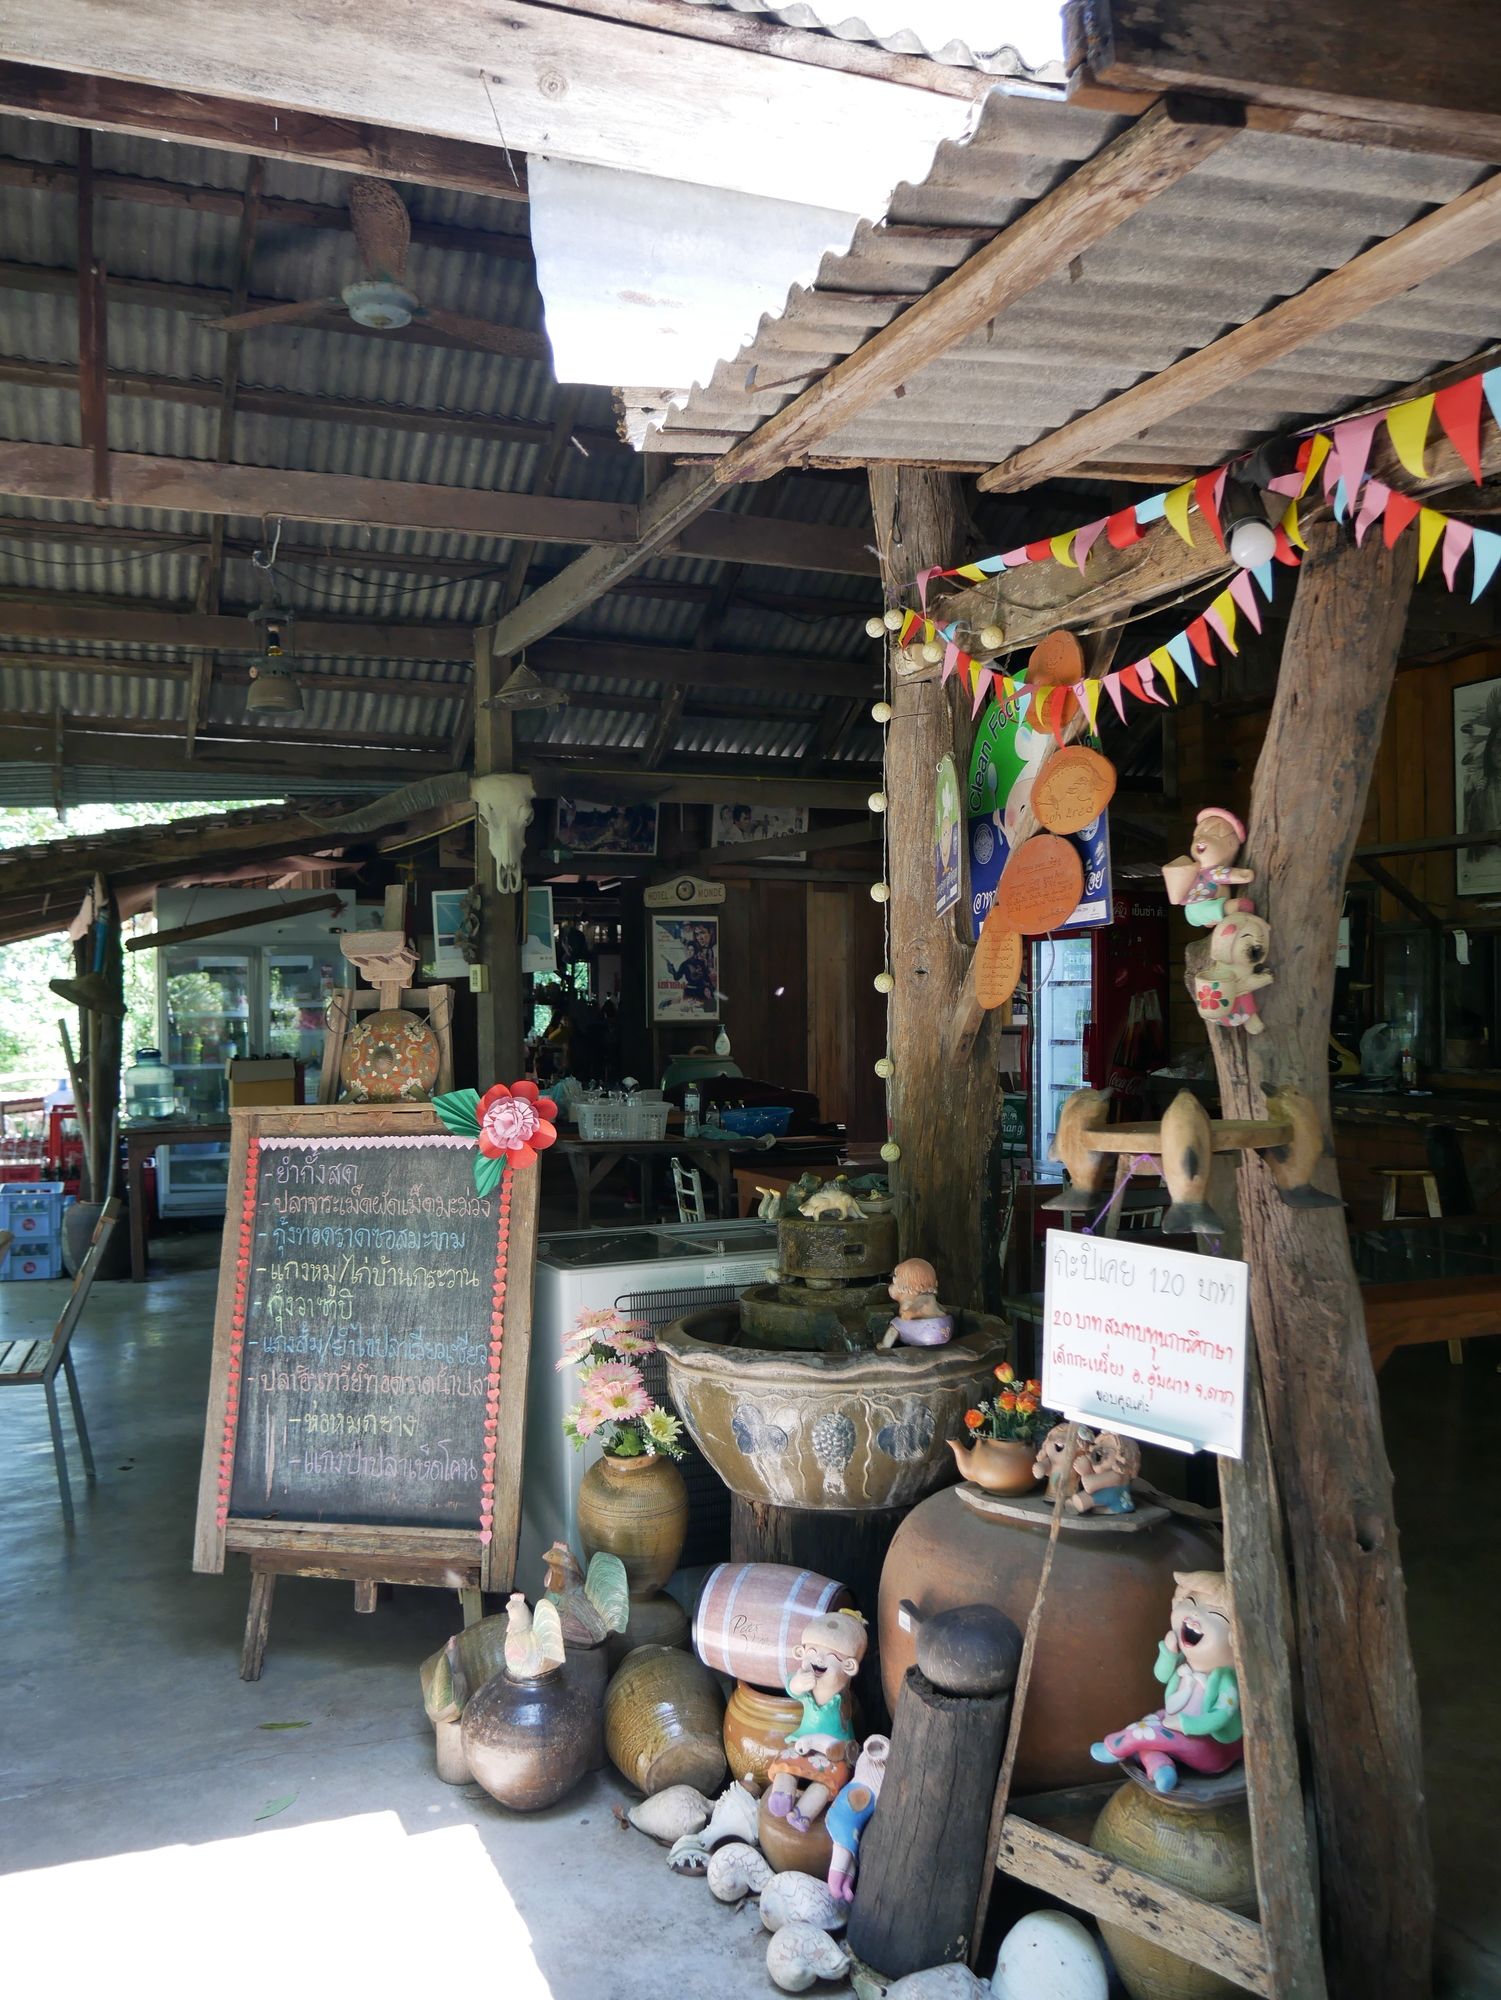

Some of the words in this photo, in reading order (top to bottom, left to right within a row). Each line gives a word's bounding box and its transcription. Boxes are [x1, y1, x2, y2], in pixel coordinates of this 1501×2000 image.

[969, 740, 992, 812] Clean
[1149, 1267, 1185, 1297] 120
[1198, 1278, 1236, 1306] บาท
